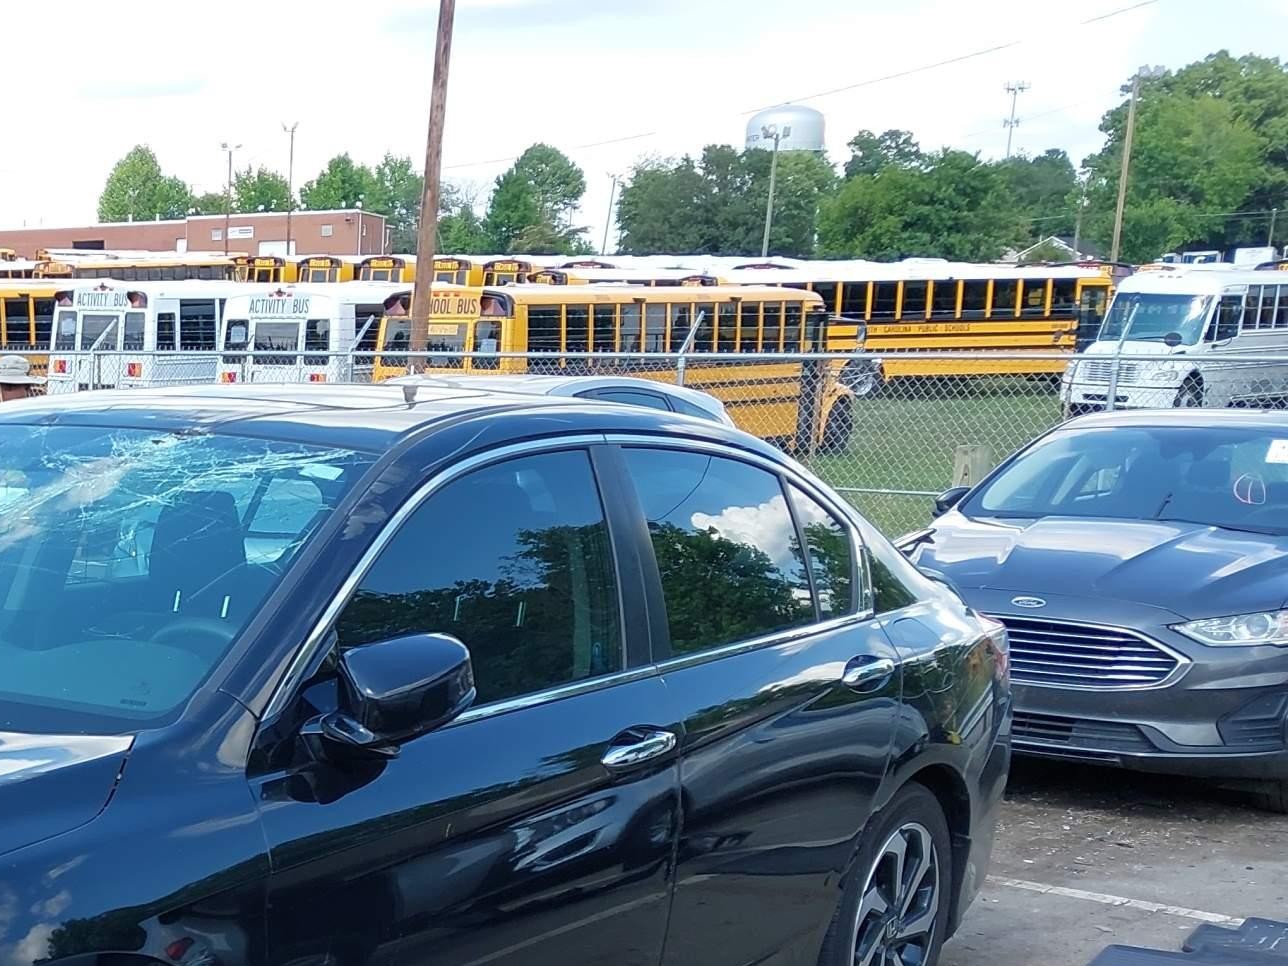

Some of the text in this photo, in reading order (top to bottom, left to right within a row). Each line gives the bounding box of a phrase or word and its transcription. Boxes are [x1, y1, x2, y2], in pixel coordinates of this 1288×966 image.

[77, 292, 128, 307] ACTIVITY BUS
[248, 298, 310, 314] ACTIVITY BUS
[429, 298, 478, 314] HOOL BUS
